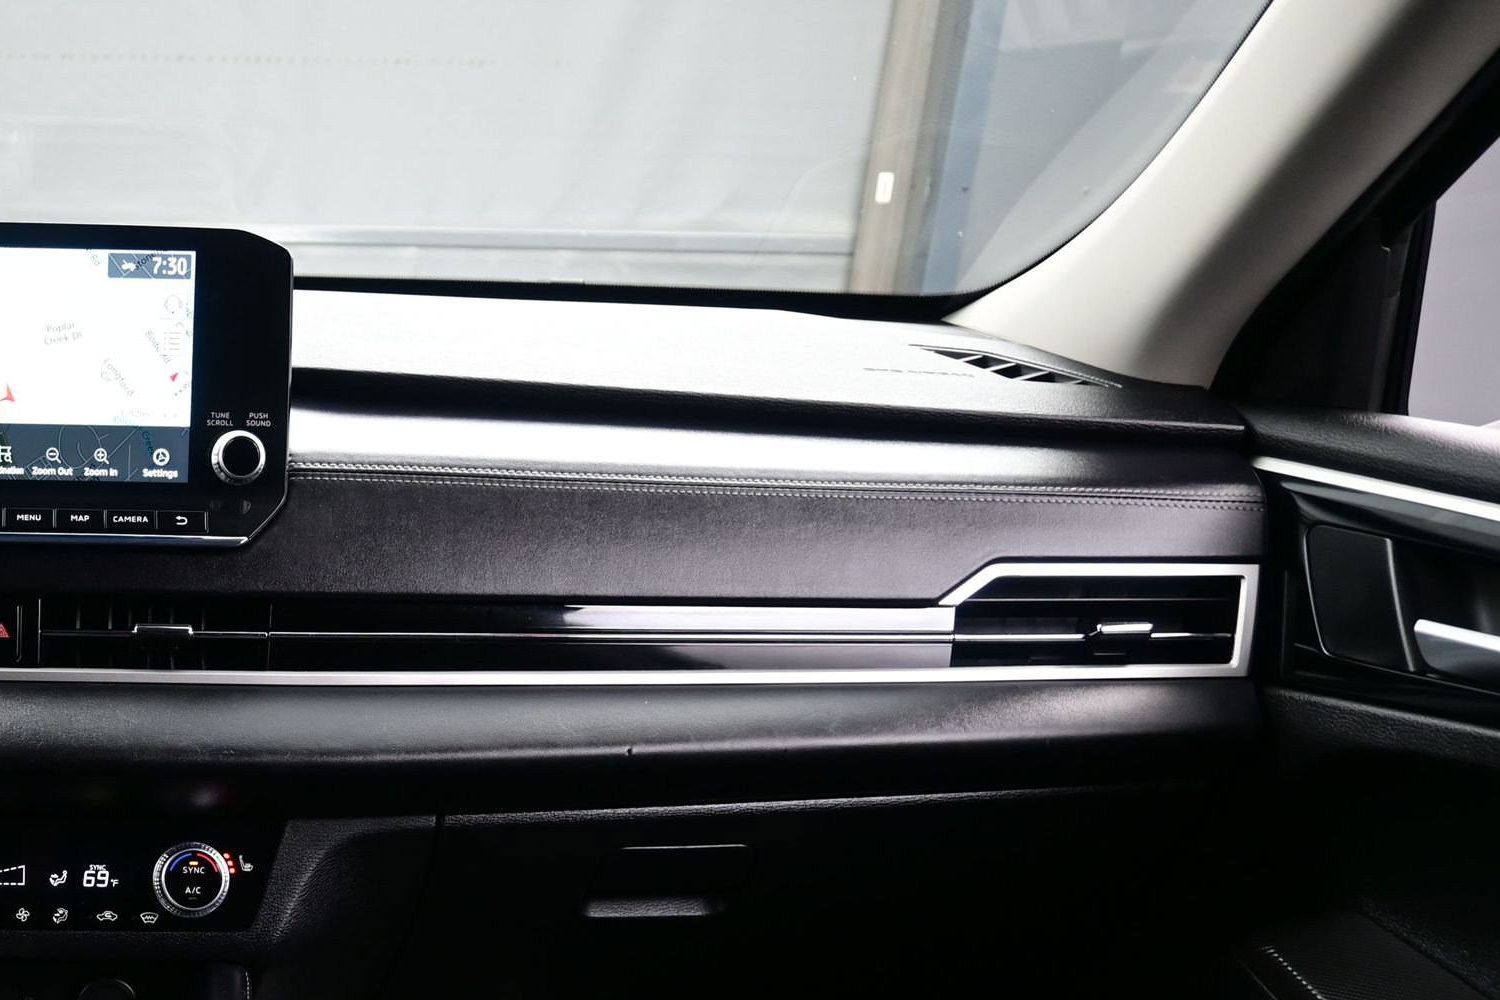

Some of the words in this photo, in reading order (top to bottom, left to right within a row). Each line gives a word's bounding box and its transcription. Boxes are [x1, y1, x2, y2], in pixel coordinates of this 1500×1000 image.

[152, 256, 188, 276] 7:30
[46, 321, 75, 334] Poplar
[43, 333, 70, 346] Creek
[103, 358, 135, 397] Longford
[210, 411, 231, 419] TUNE
[248, 412, 269, 420] PUSH
[206, 419, 234, 427] SCROLL
[245, 419, 272, 427] SOUND
[31, 466, 57, 476] Zoom
[57, 467, 74, 477] Out
[84, 467, 108, 477] Zoom
[109, 467, 118, 477] In
[142, 468, 179, 480] Settings
[16, 514, 42, 522] MENU
[70, 514, 90, 522] MAP
[112, 515, 149, 523] CAMERA
[182, 866, 206, 875] SYNC
[185, 886, 202, 895] A/C
